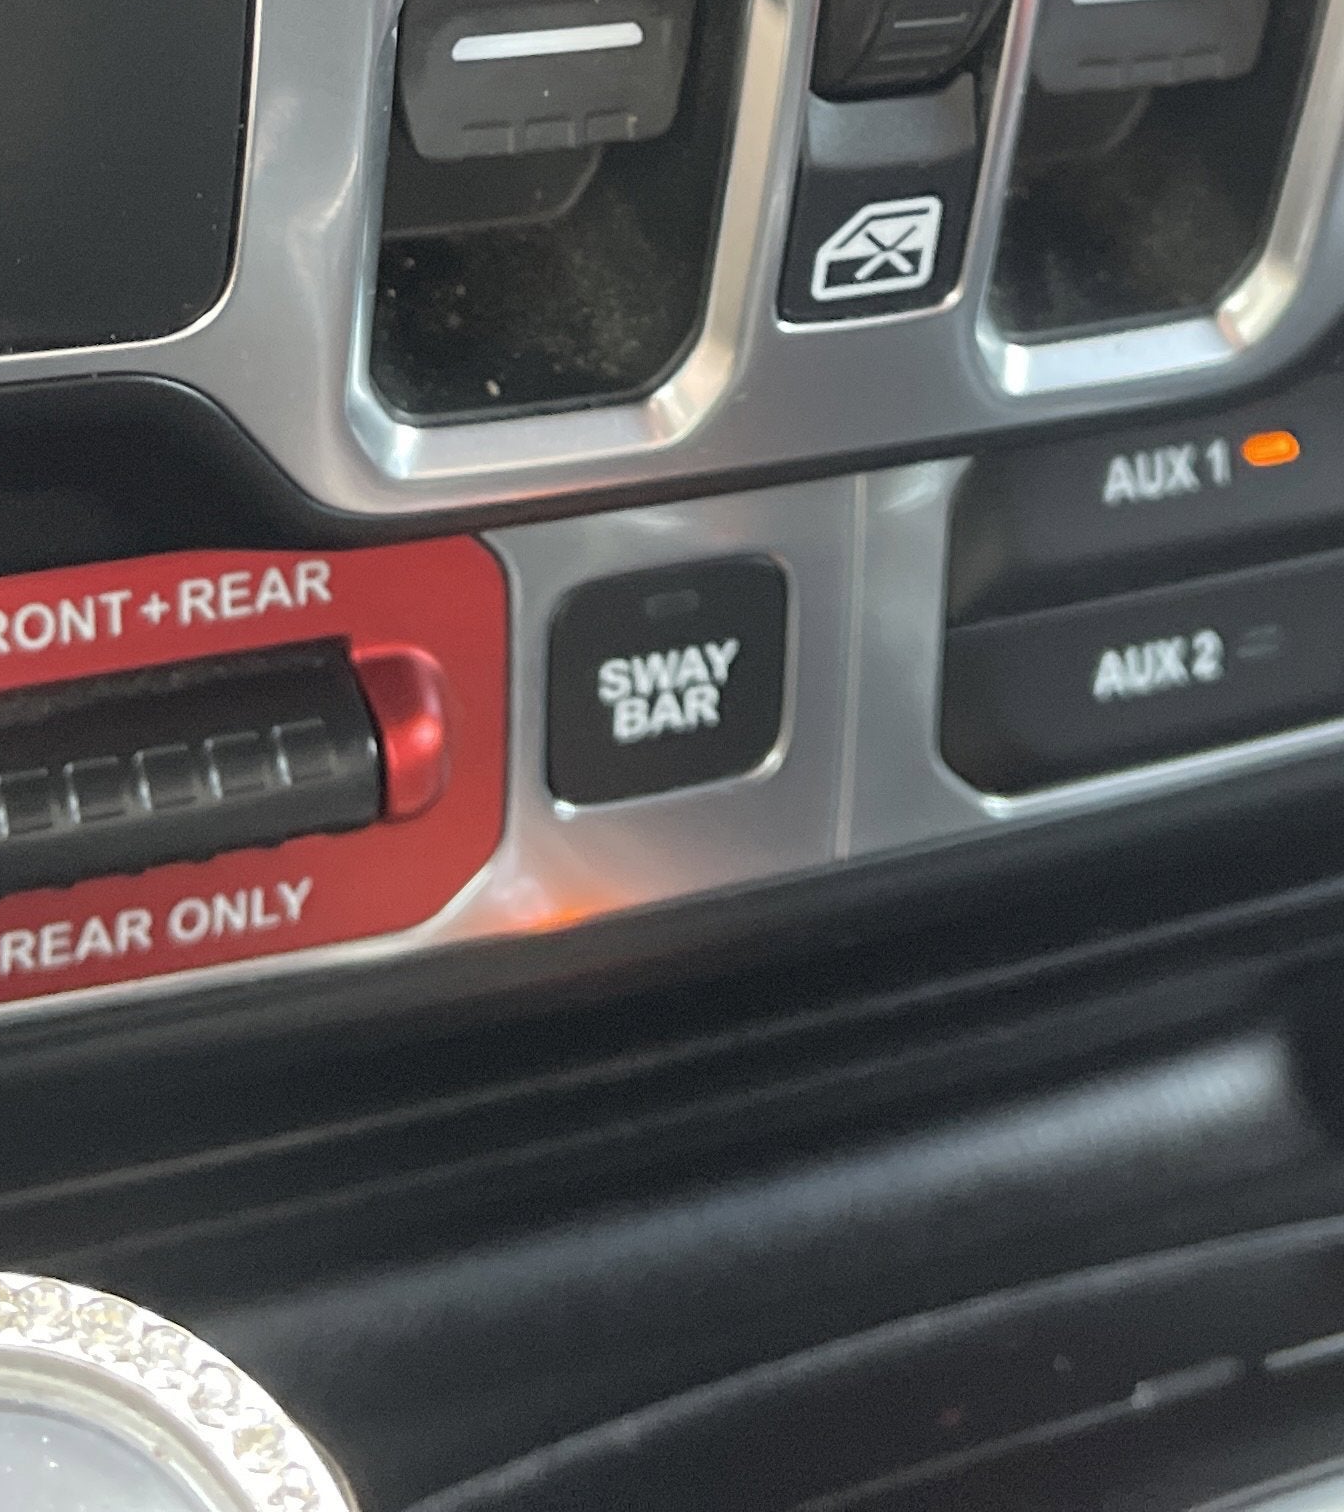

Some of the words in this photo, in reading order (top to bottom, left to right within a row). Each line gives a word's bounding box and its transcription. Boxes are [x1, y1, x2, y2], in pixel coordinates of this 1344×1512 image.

[1103, 448, 1201, 505] AUX
[1209, 440, 1232, 484] 1
[598, 638, 738, 702] SWAY
[1092, 643, 1186, 701] AUX
[1193, 630, 1223, 680] 2
[612, 687, 720, 745] BAR
[166, 878, 312, 945] ONLY
